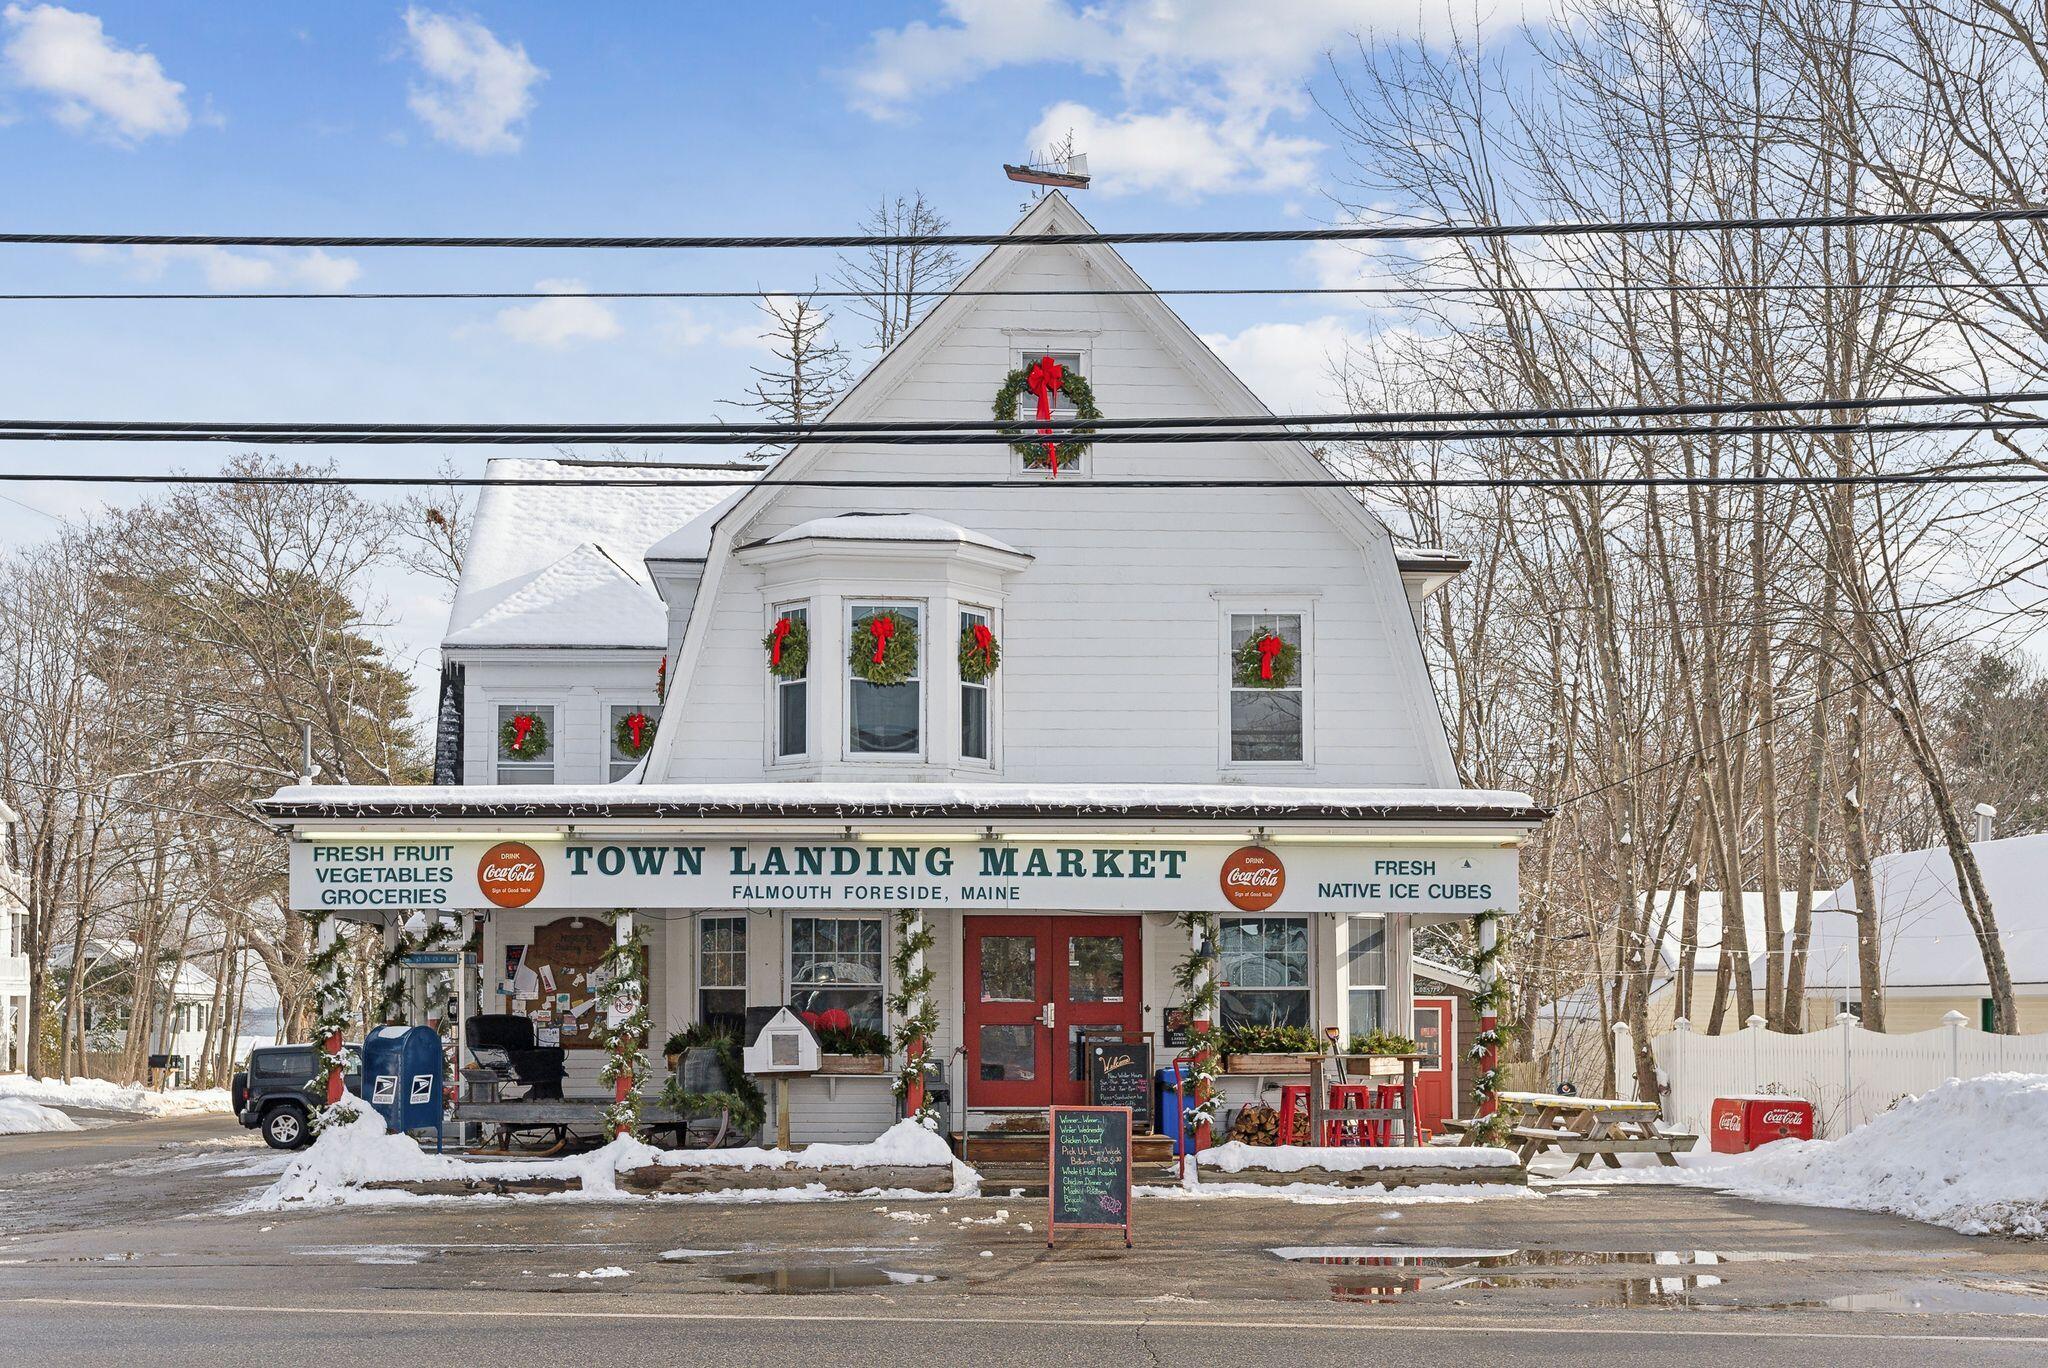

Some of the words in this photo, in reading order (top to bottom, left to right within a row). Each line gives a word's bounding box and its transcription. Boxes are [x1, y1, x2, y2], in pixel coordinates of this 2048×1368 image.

[313, 846, 384, 862] FRESH
[394, 846, 454, 861] FRUIT
[566, 846, 706, 876] TOWN
[730, 846, 954, 877] LANDING
[979, 848, 1187, 879] MARKET
[1374, 860, 1436, 876] FRESH
[316, 867, 454, 883] VEGETABLES
[483, 863, 537, 882] Coca-Cola
[1227, 868, 1280, 886] Coca-Cola
[321, 888, 447, 905] GROCERIES
[732, 886, 832, 900] FALMOUTH
[844, 886, 949, 902] FORESIDE,
[961, 886, 1020, 900] MAINE
[1318, 883, 1381, 898] NATIVE
[1390, 883, 1420, 899] ICE
[1428, 884, 1492, 900] CUBES
[1763, 1111, 1804, 1125] Coca-Cola
[1060, 1135, 1081, 1144] Chicken
[1062, 1146, 1076, 1155] Pick
[1078, 1147, 1088, 1158] Up
[1089, 1146, 1104, 1158] Every
[1083, 1167, 1096, 1176] Half
